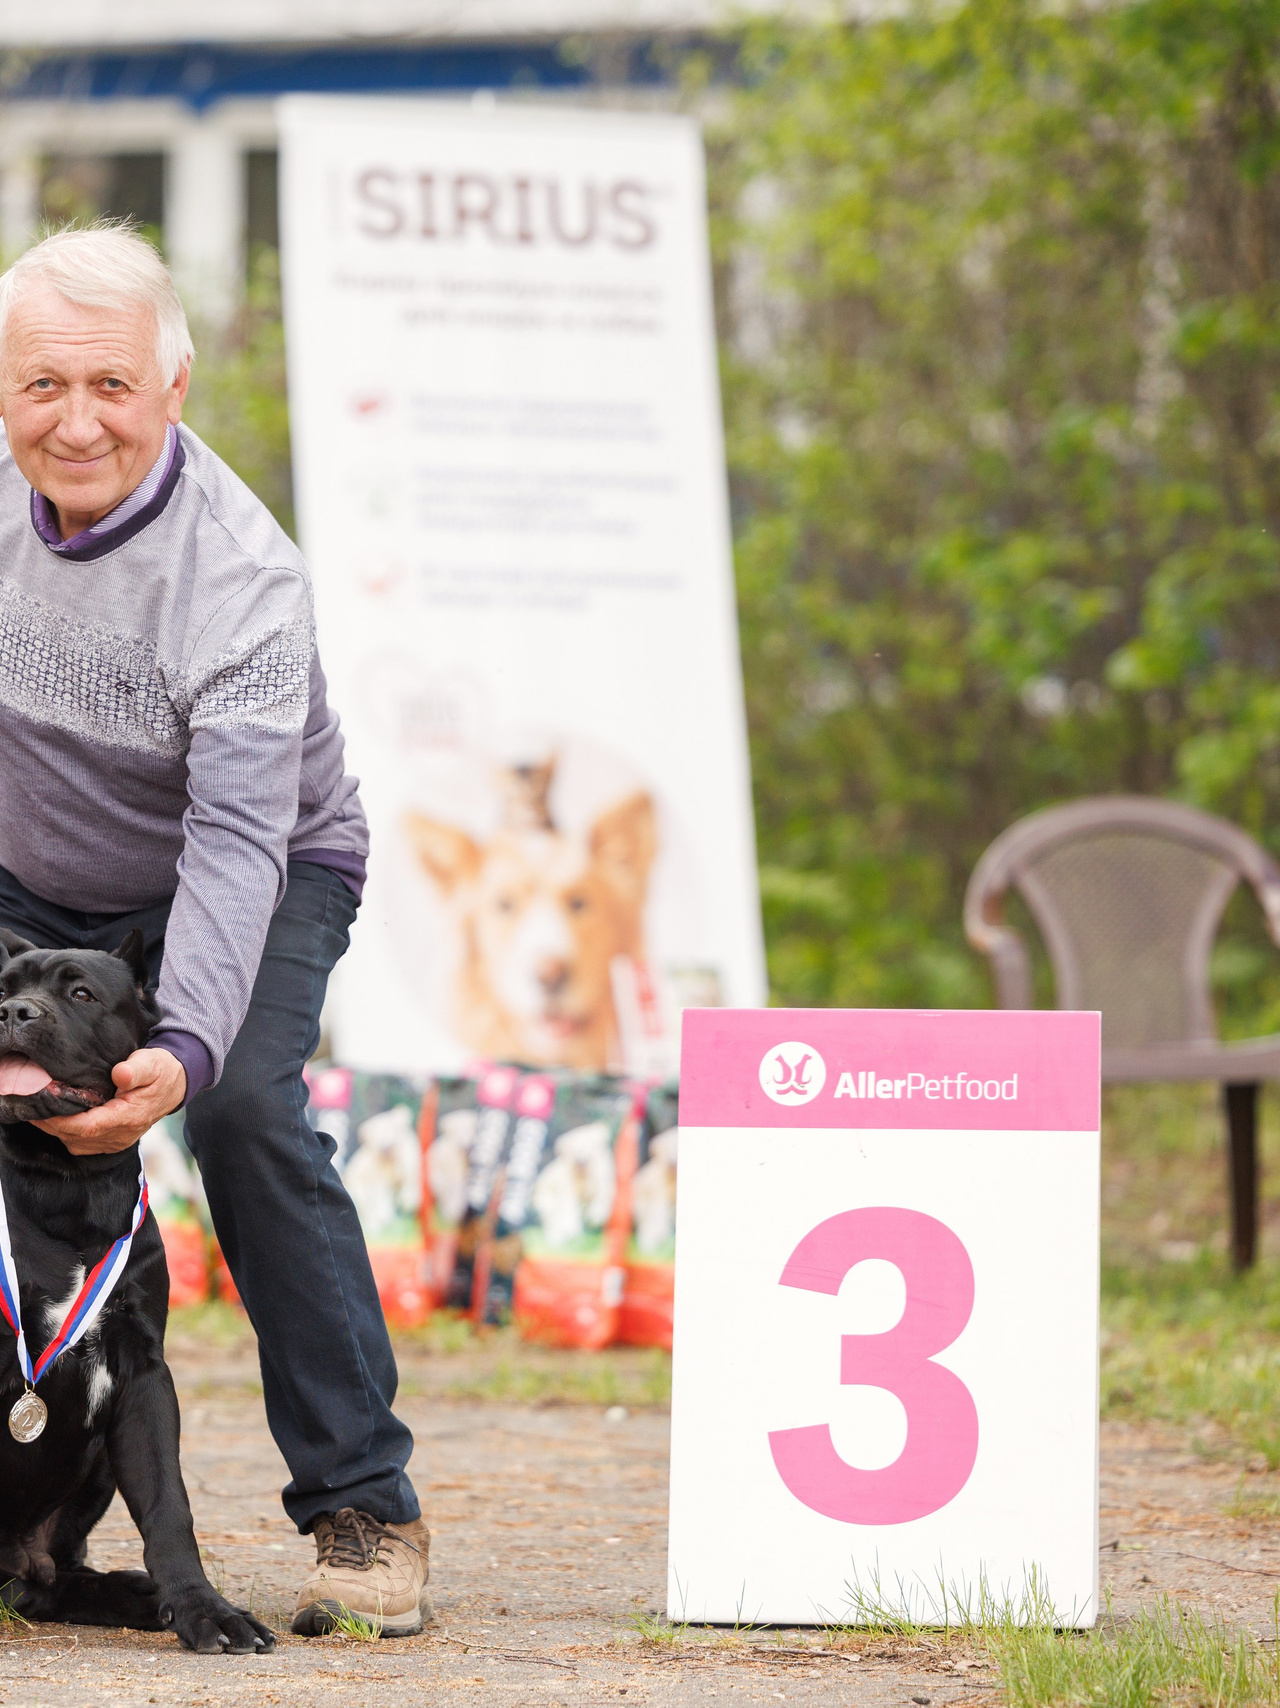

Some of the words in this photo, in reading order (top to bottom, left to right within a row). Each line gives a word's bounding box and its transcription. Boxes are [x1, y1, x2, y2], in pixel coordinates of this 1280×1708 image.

[355, 166, 659, 252] SIRIUS
[833, 1071, 1018, 1100] AllerPetfood
[767, 1206, 979, 1526] 3
[21, 1407, 35, 1428] 2
